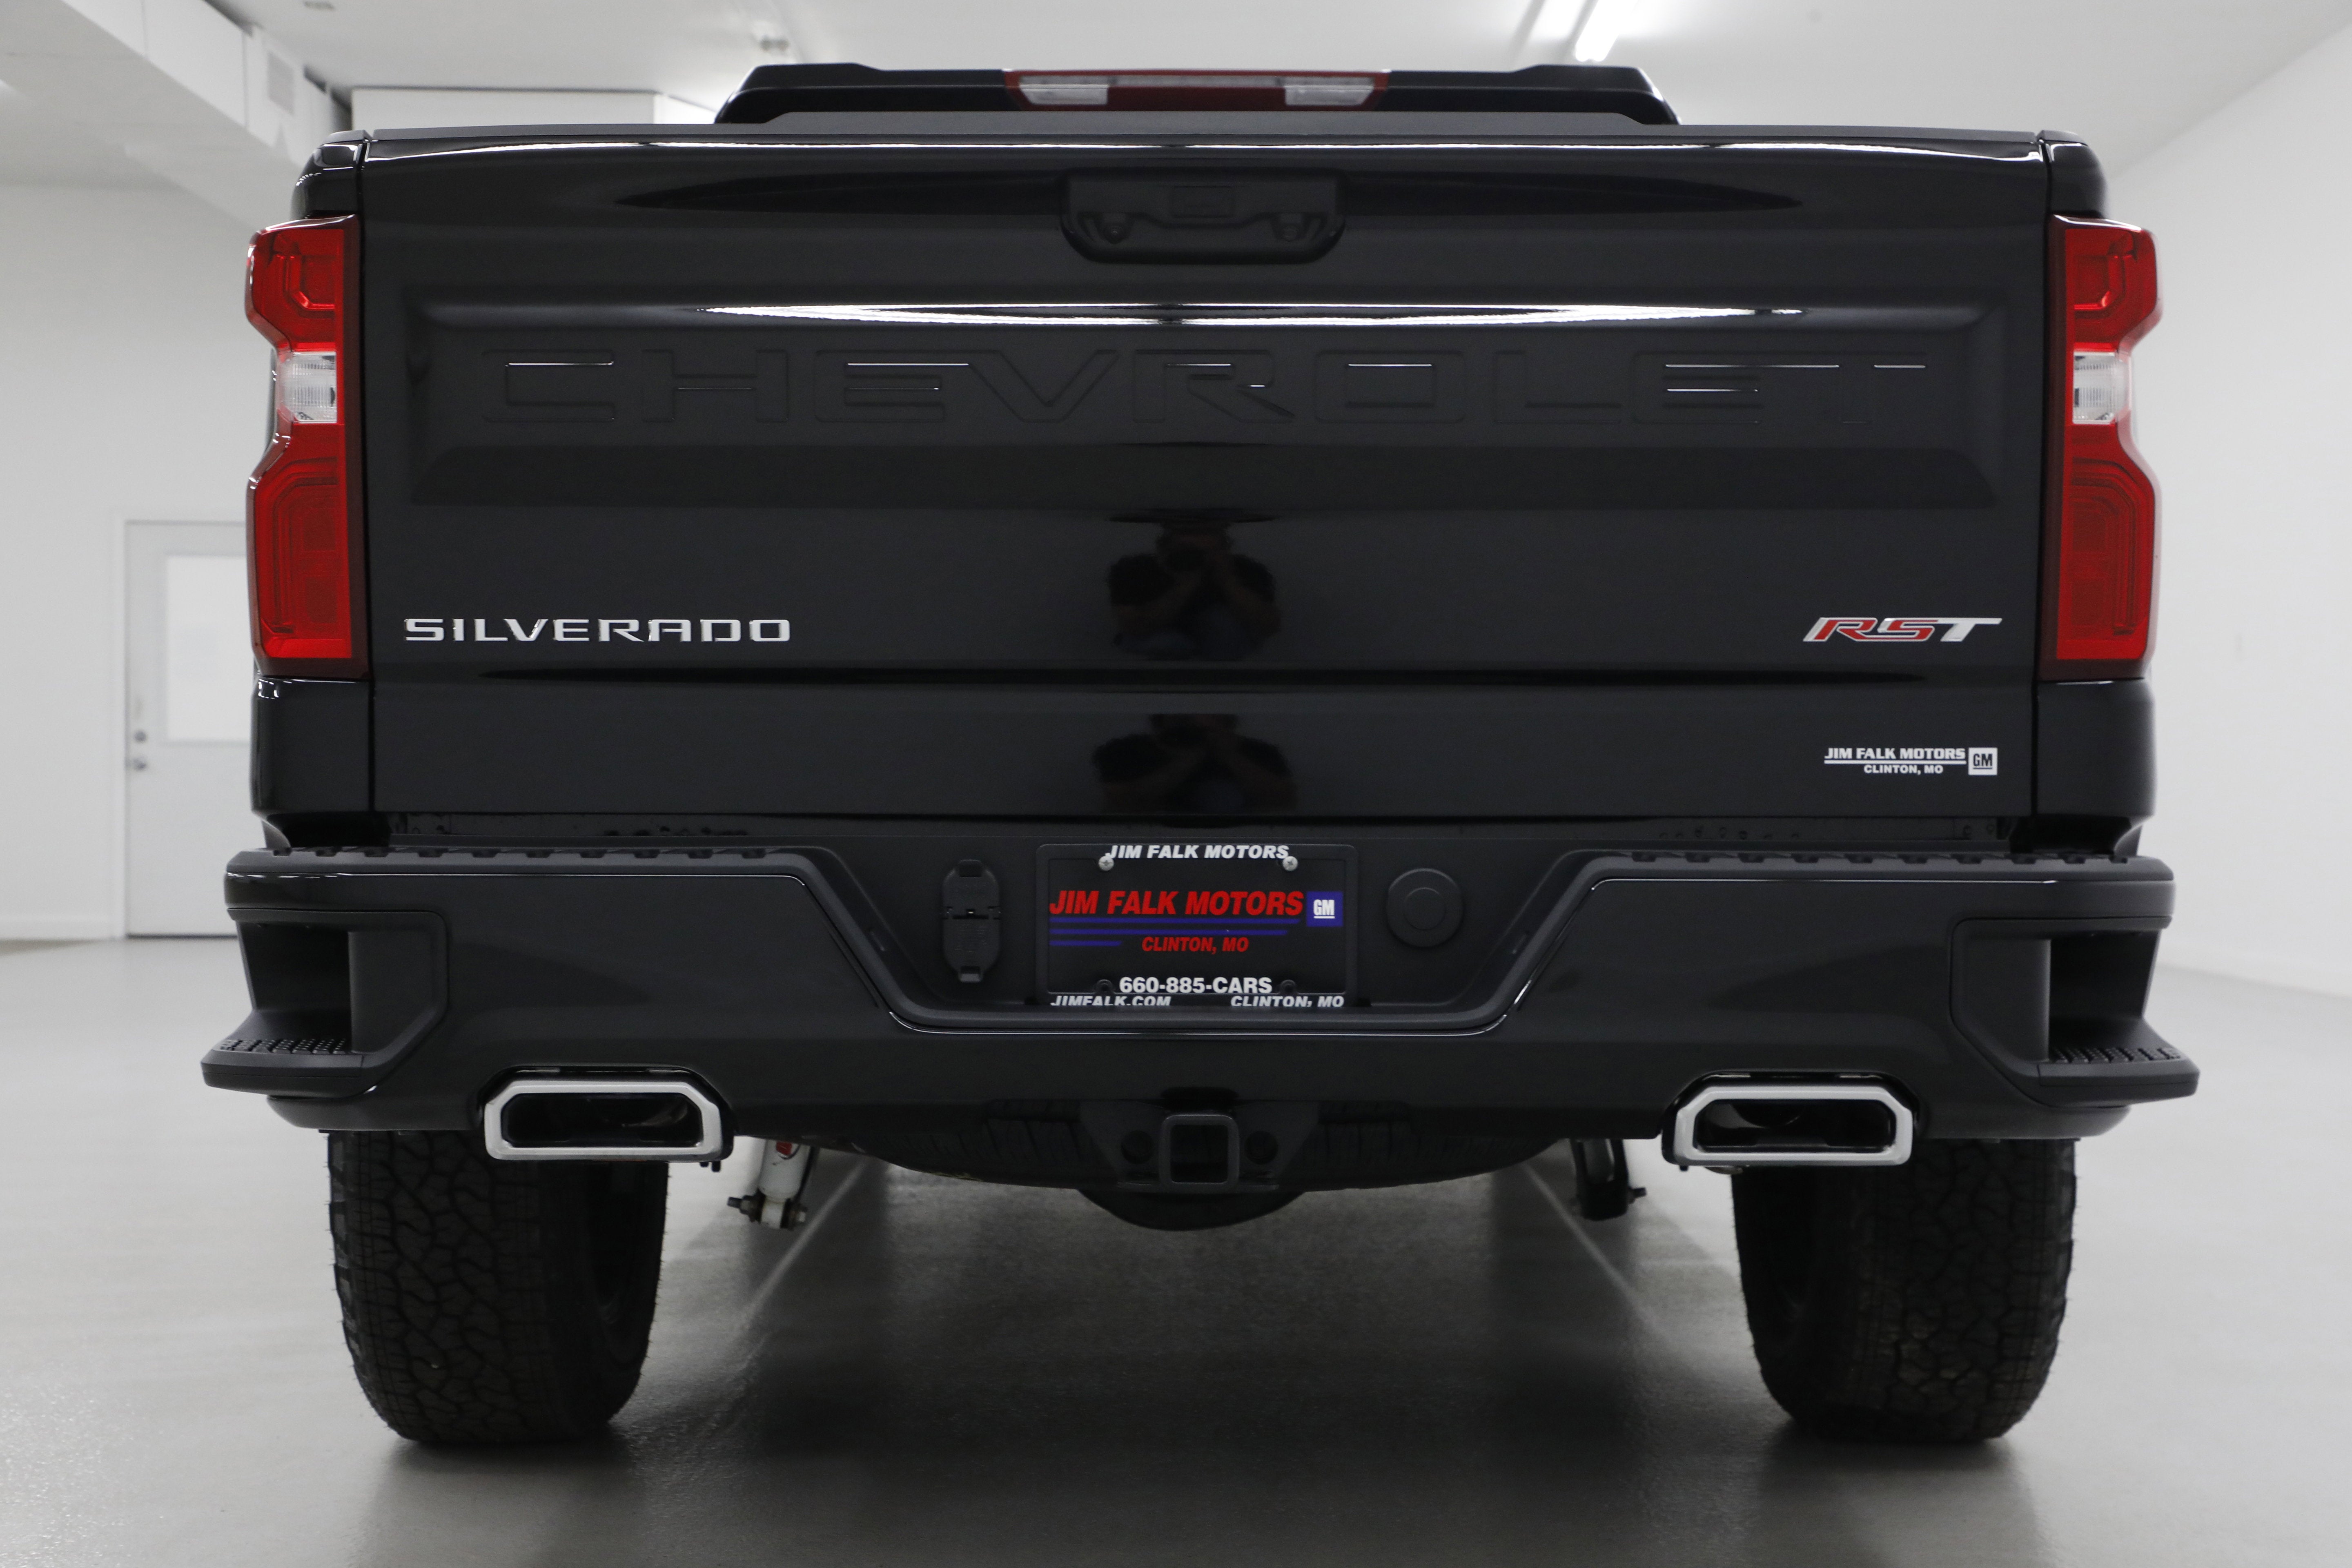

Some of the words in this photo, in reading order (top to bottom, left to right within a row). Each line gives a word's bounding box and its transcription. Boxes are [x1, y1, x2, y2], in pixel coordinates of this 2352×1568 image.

[481, 350, 1927, 423] CHEVROLET
[404, 619, 790, 642] SILVERADO
[1803, 617, 2002, 642] RST
[1824, 748, 1852, 759] JIM
[1856, 748, 1896, 759] FALK
[1900, 748, 1965, 760] MOTORS
[1973, 754, 1993, 766] GM
[1864, 765, 1921, 775] CLINTON,
[1924, 765, 1943, 774] MO
[1103, 845, 1142, 859] JIM
[1147, 845, 1199, 858] FALK
[1204, 845, 1289, 859] MOTORS
[1050, 891, 1098, 914] JIM
[1107, 891, 1178, 914] FALK
[1185, 891, 1303, 915] MOTORS
[1314, 900, 1334, 915] GM
[1143, 937, 1216, 953] CLINTON,
[1223, 938, 1248, 951] MO
[1120, 977, 1272, 993] 660-885-CARS
[1051, 996, 1171, 1006] JIMFALK.COM
[1231, 996, 1312, 1007] CLINTON,
[1318, 996, 1344, 1007] MO
